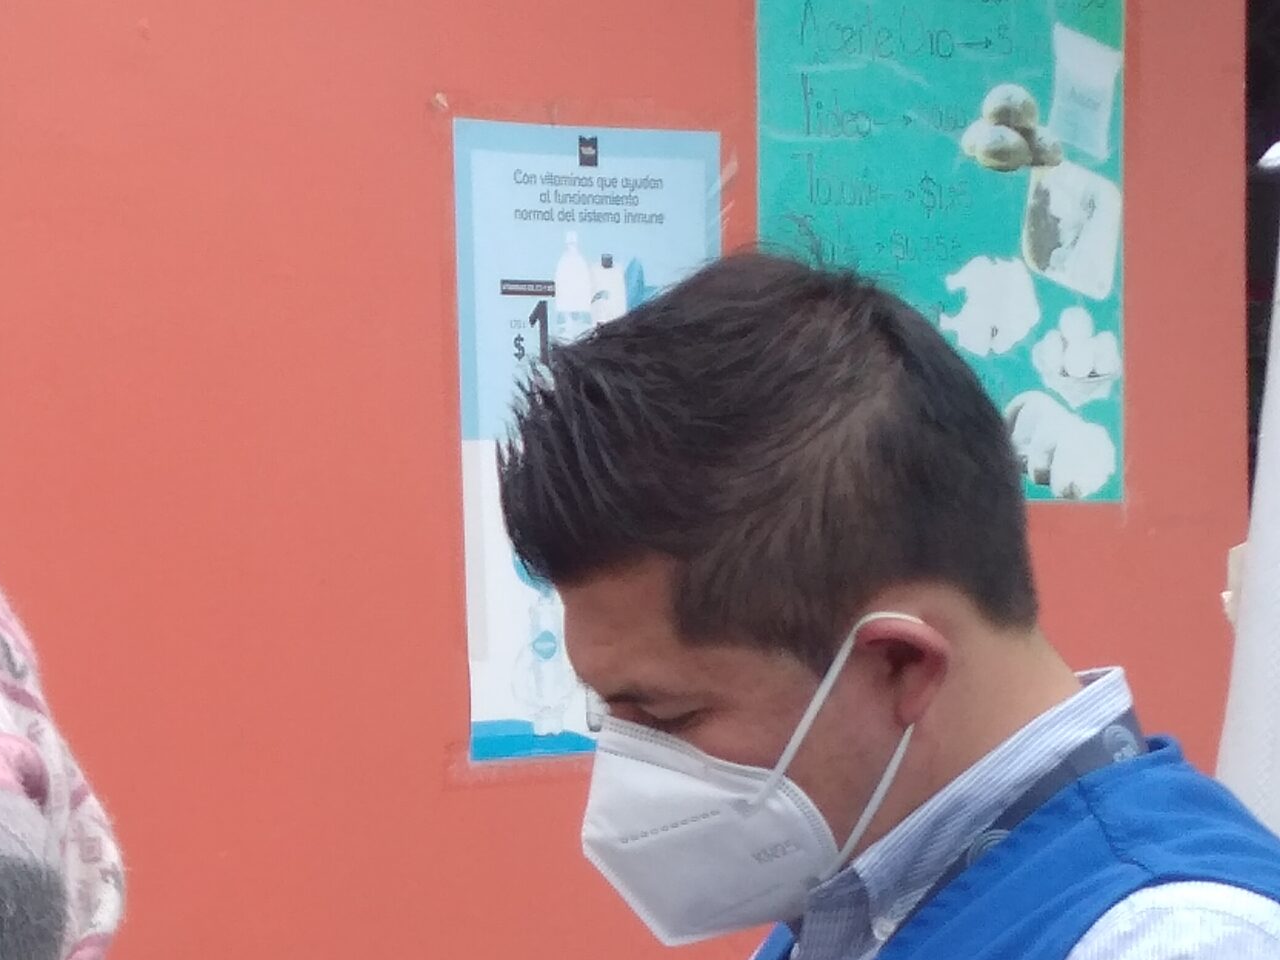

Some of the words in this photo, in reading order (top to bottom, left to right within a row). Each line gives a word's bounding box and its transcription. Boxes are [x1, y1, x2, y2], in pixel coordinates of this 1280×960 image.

[513, 168, 537, 185] Con
[540, 171, 593, 188] vitaminas
[596, 174, 618, 191] que
[621, 174, 663, 192] ayudan
[540, 190, 550, 204] al
[554, 189, 639, 207] funcionamiento
[514, 207, 554, 223] normal
[557, 208, 575, 223] del
[578, 208, 620, 224] sistema
[624, 210, 665, 225] inmune
